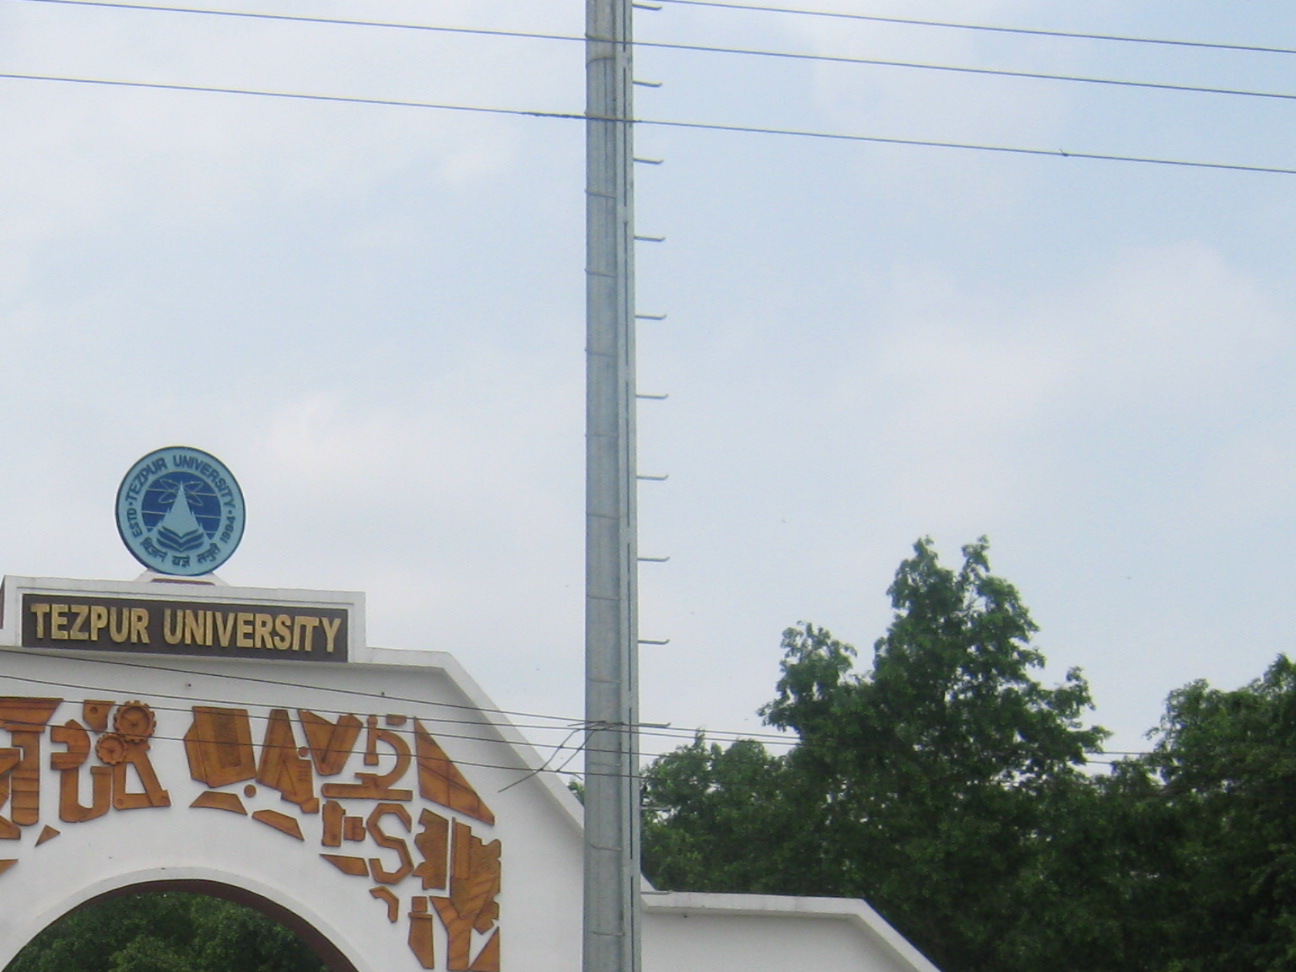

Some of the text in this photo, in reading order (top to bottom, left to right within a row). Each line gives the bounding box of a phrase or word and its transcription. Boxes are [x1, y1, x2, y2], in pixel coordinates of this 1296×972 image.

[125, 454, 236, 508] TEZPUR UNIVERSITY
[30, 603, 342, 652] TEZPUR UNIVERSITY
